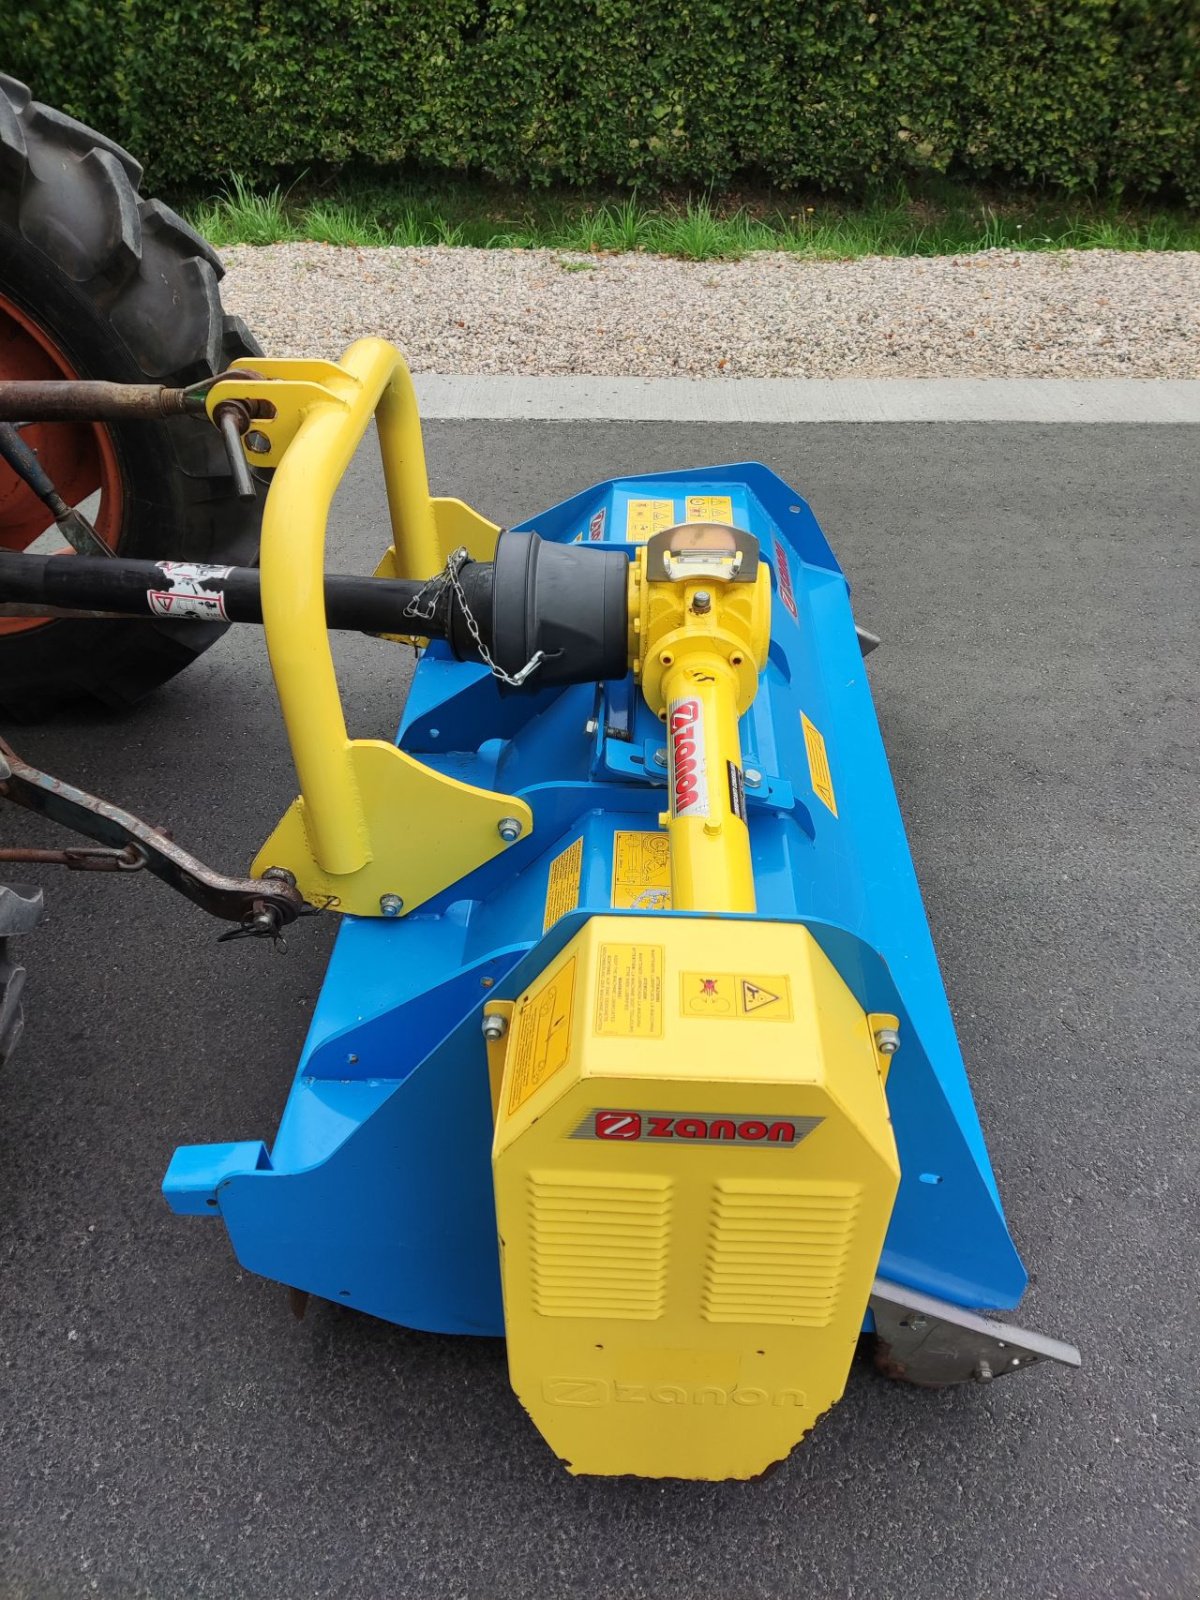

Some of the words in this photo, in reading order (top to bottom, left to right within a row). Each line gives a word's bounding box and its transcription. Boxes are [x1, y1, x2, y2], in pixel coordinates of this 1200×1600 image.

[673, 727, 700, 813] zanon
[647, 1117, 796, 1143] zanon
[614, 1383, 808, 1407] zanon
